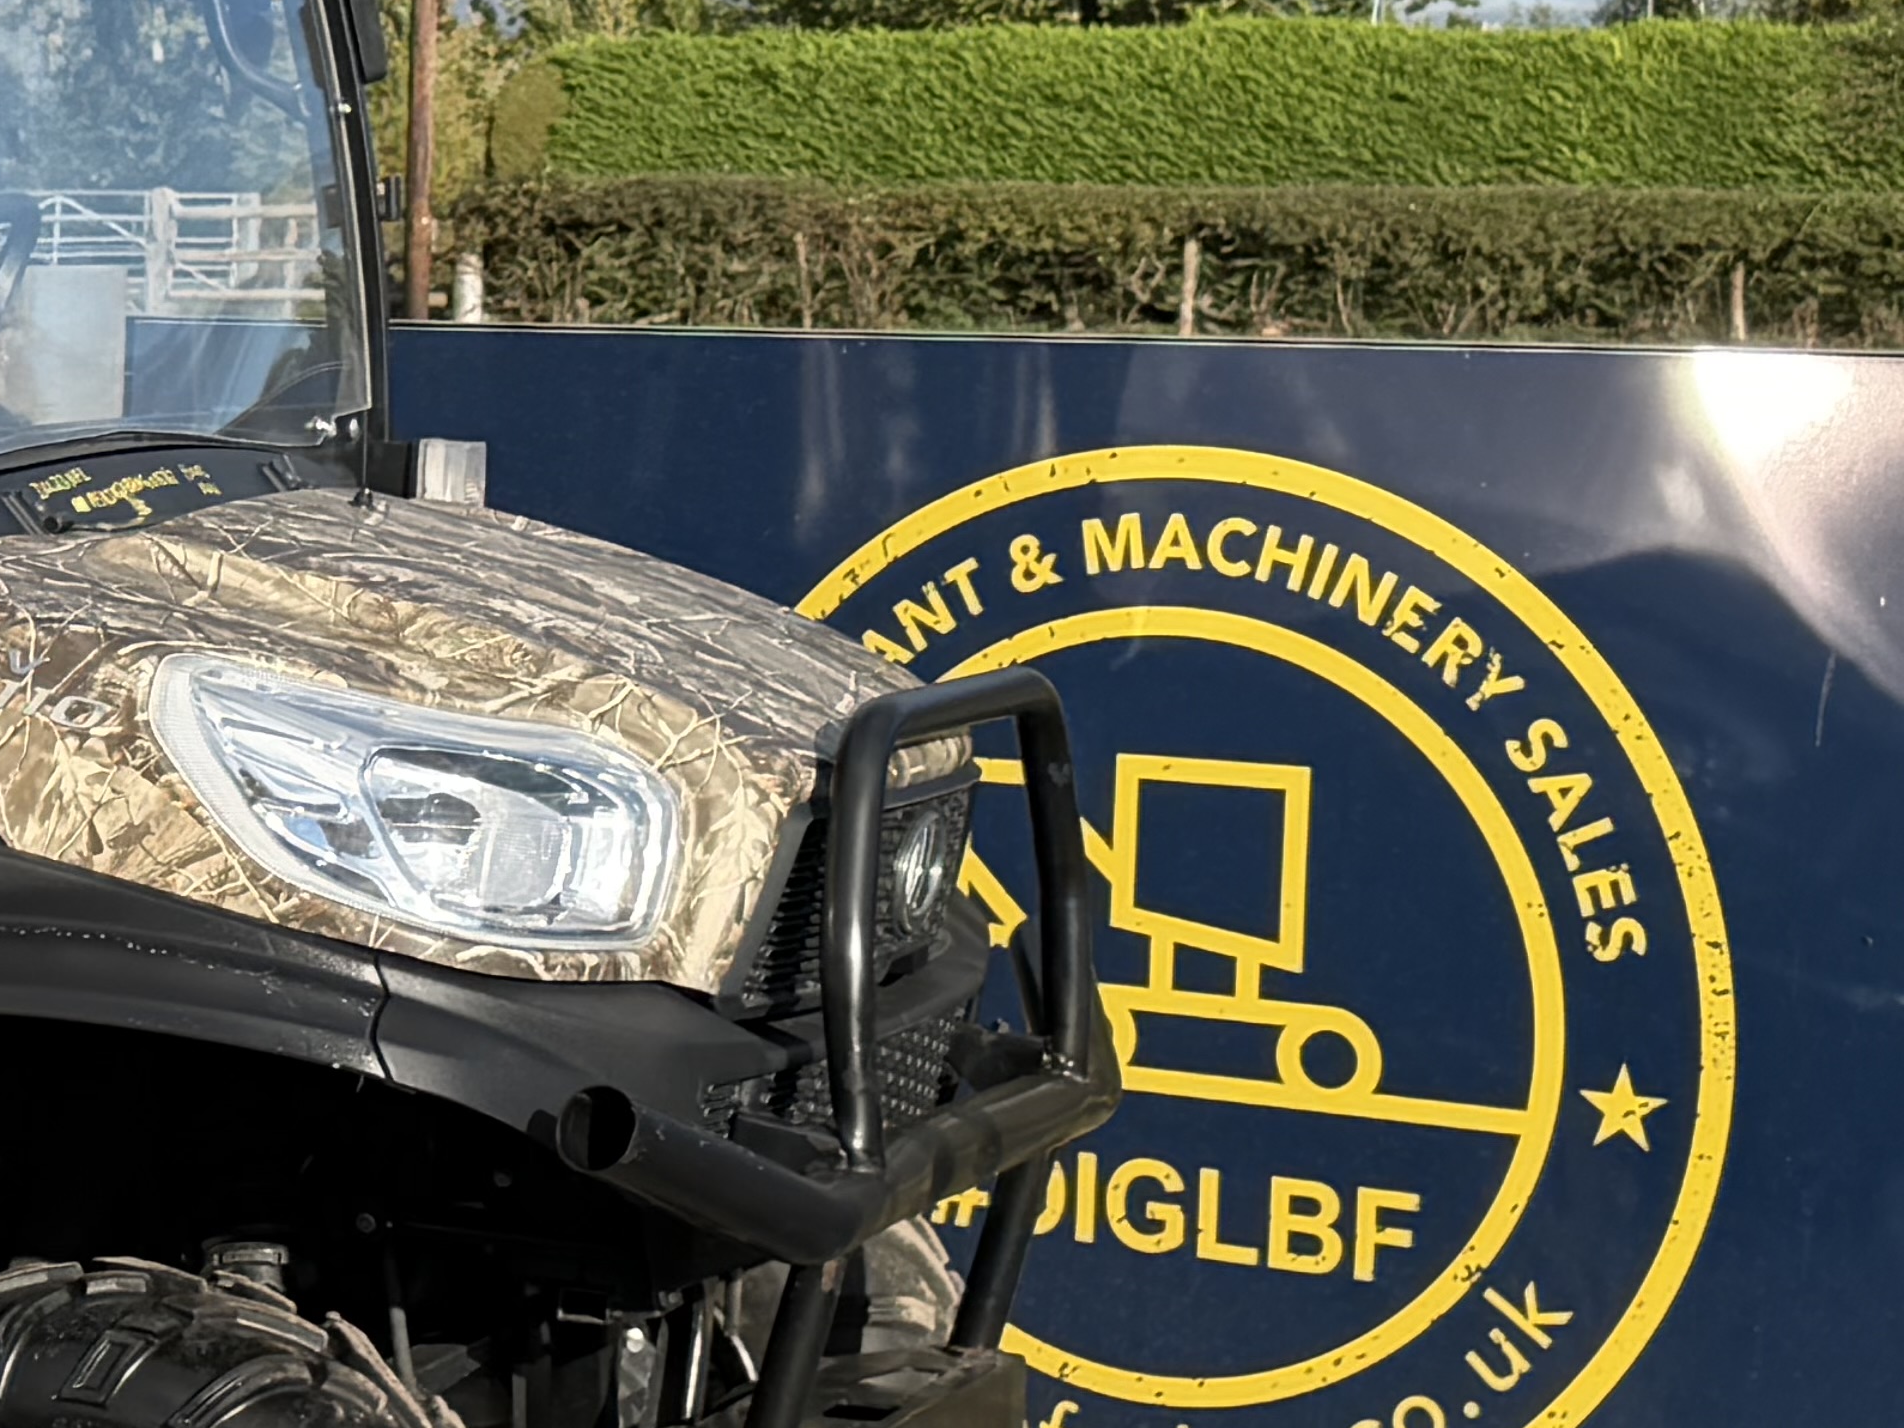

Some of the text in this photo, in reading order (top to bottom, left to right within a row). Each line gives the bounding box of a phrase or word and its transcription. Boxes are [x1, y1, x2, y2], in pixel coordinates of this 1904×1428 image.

[861, 512, 1648, 963] ANT & MACHINERY SALES
